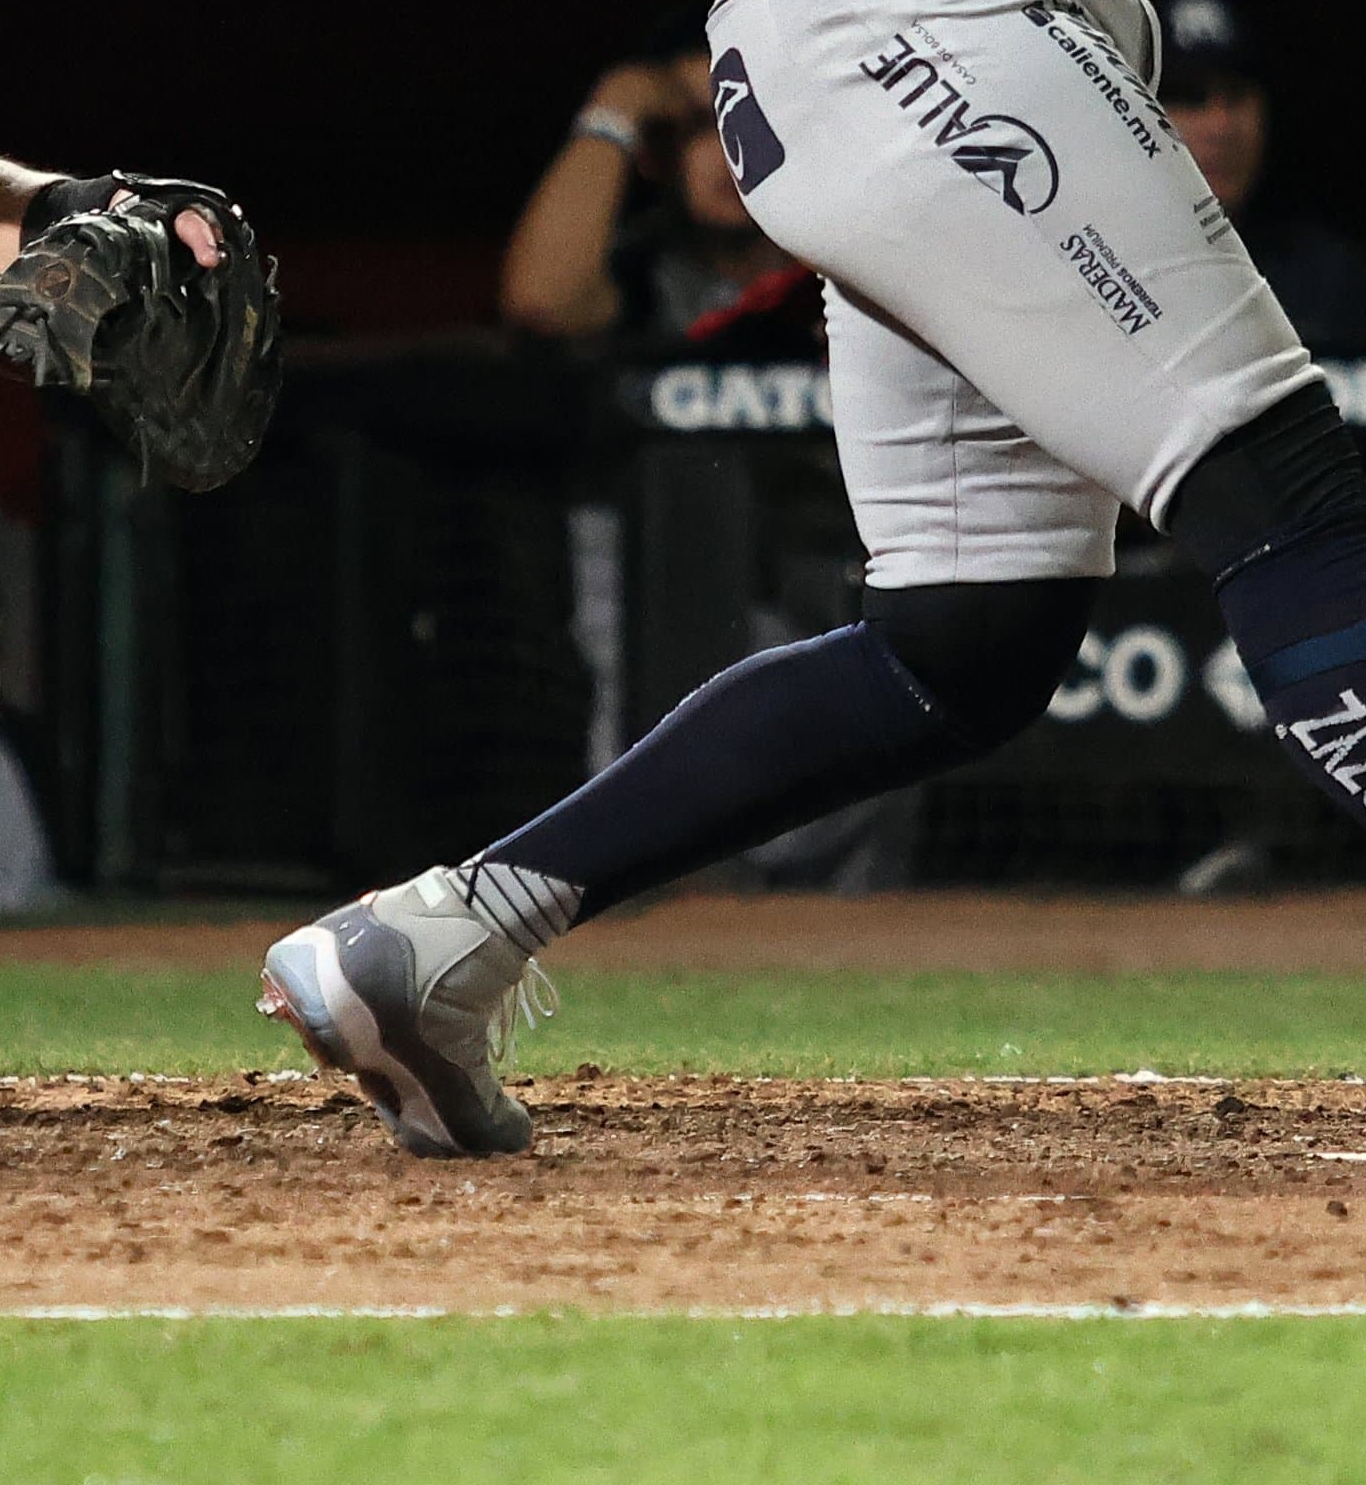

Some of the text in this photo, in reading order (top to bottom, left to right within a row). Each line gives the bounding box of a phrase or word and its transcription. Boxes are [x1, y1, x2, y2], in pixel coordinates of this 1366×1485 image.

[1048, 24, 1162, 159] caliente.mx
[1060, 234, 1152, 336] MADERAS
[1082, 223, 1163, 320] TERRENOS PREMIUM
